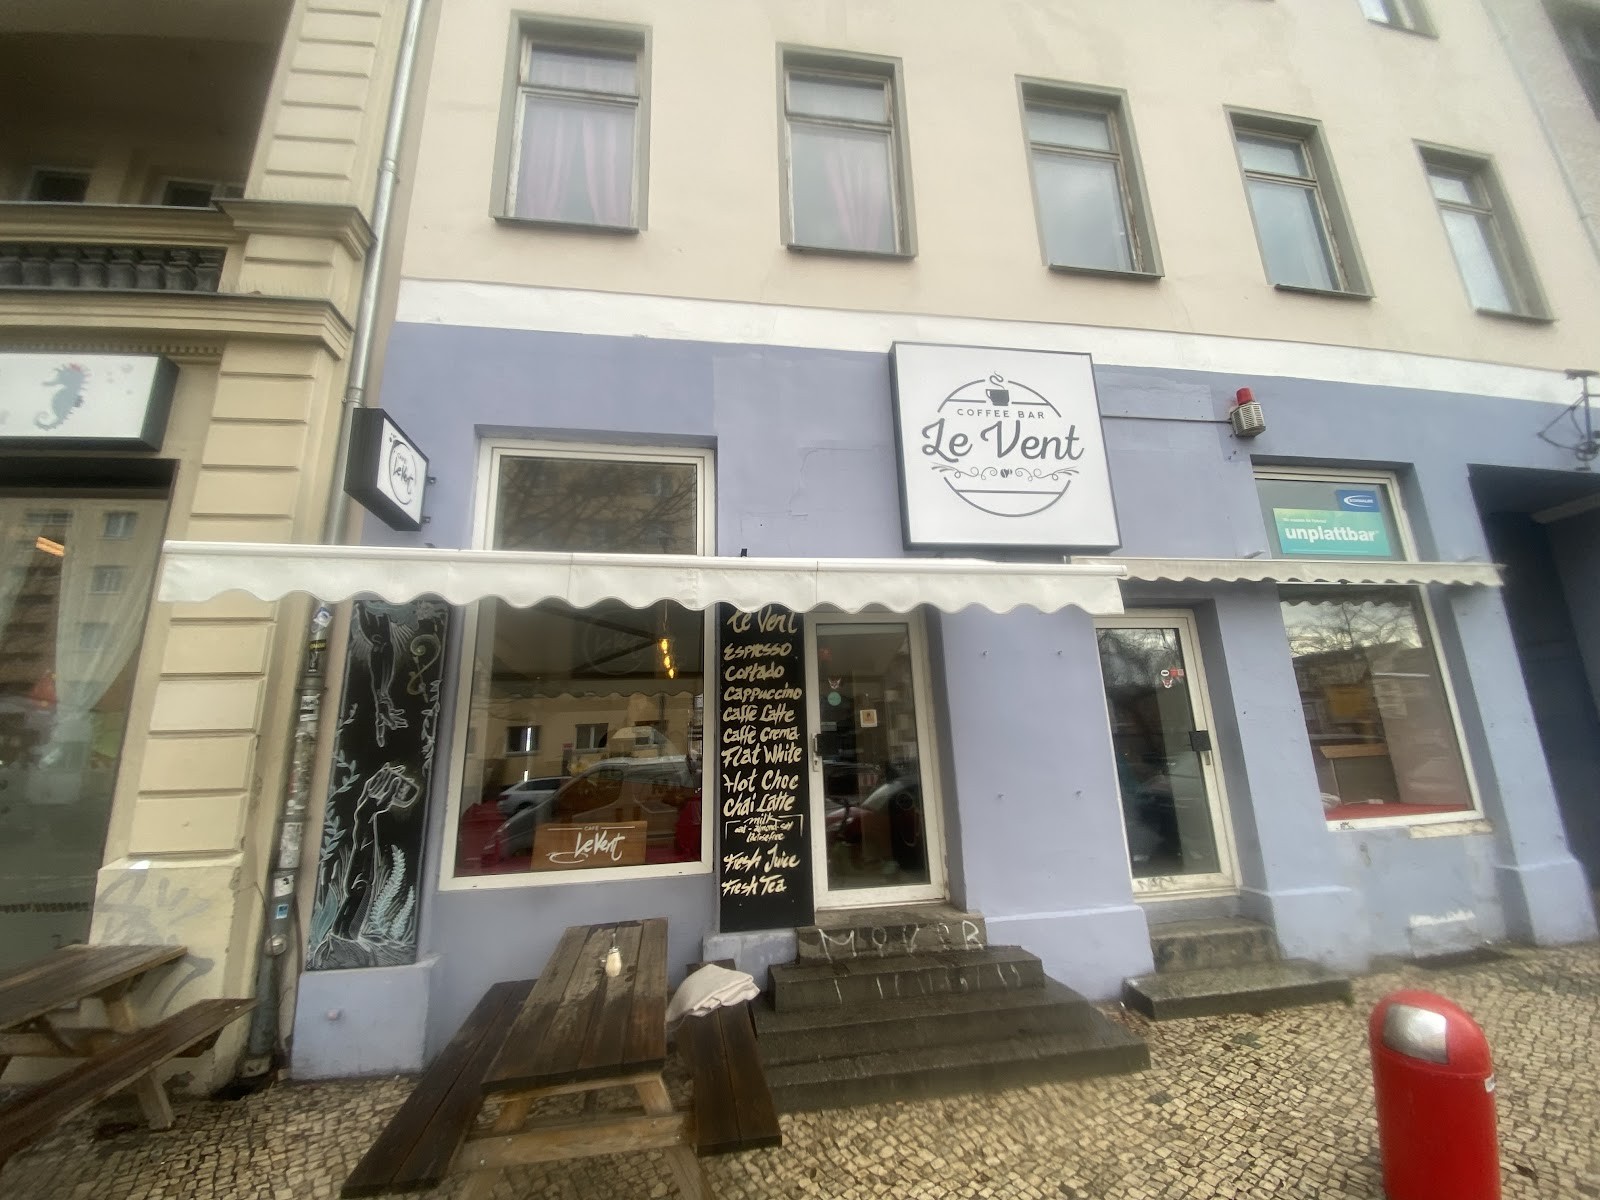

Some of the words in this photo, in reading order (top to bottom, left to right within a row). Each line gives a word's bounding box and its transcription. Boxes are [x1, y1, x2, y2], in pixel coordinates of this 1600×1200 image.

[957, 408, 1010, 418] COFFEE
[1018, 410, 1045, 419] BAR
[921, 417, 973, 463] Le
[980, 419, 1085, 461] Vent
[724, 661, 785, 682] Cortado
[723, 682, 803, 703] Cappuccino
[759, 703, 795, 725] Latte
[760, 726, 800, 742] Crema
[721, 743, 761, 768] Flat
[763, 742, 802, 764] White
[722, 768, 758, 793] Hot
[761, 769, 799, 790] Choc
[723, 792, 757, 817] Chai
[756, 791, 795, 812] Latte
[723, 848, 762, 874] Fresh
[764, 843, 800, 873] Juice
[721, 875, 758, 897] Fresh
[759, 874, 787, 896] Tea
